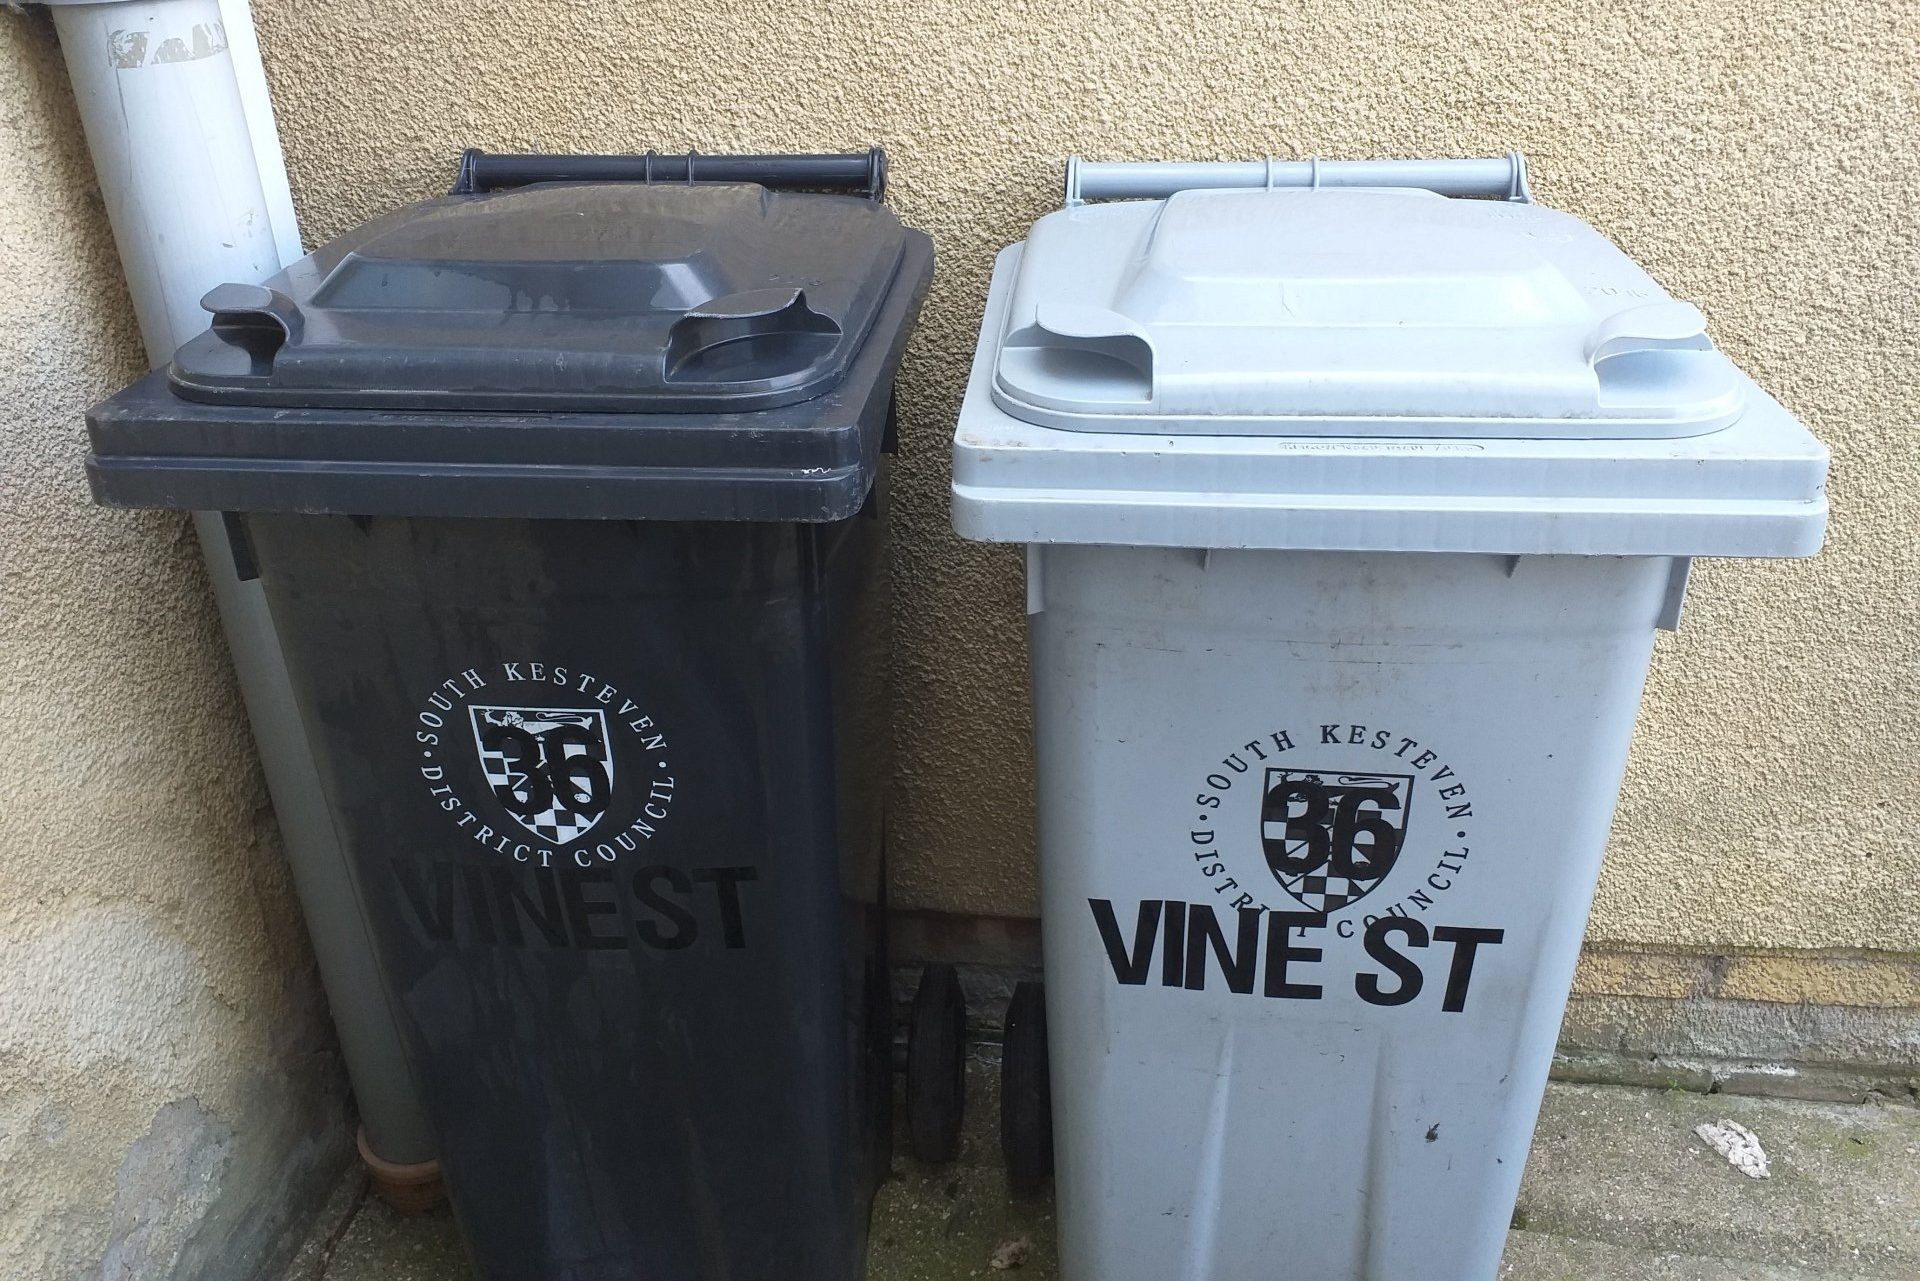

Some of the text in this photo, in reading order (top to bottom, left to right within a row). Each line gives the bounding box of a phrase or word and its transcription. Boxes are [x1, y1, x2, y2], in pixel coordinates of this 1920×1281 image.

[416, 661, 667, 752] SOUTH KESTEVEN
[420, 765, 675, 868] DISTRICT COUNCIL
[485, 724, 611, 816] 36
[1196, 724, 1473, 820] SOUTH KESTEVEN
[1266, 780, 1402, 881] 36
[1190, 829, 1307, 938] DISTRI
[1088, 897, 1505, 1013] VINE ST
